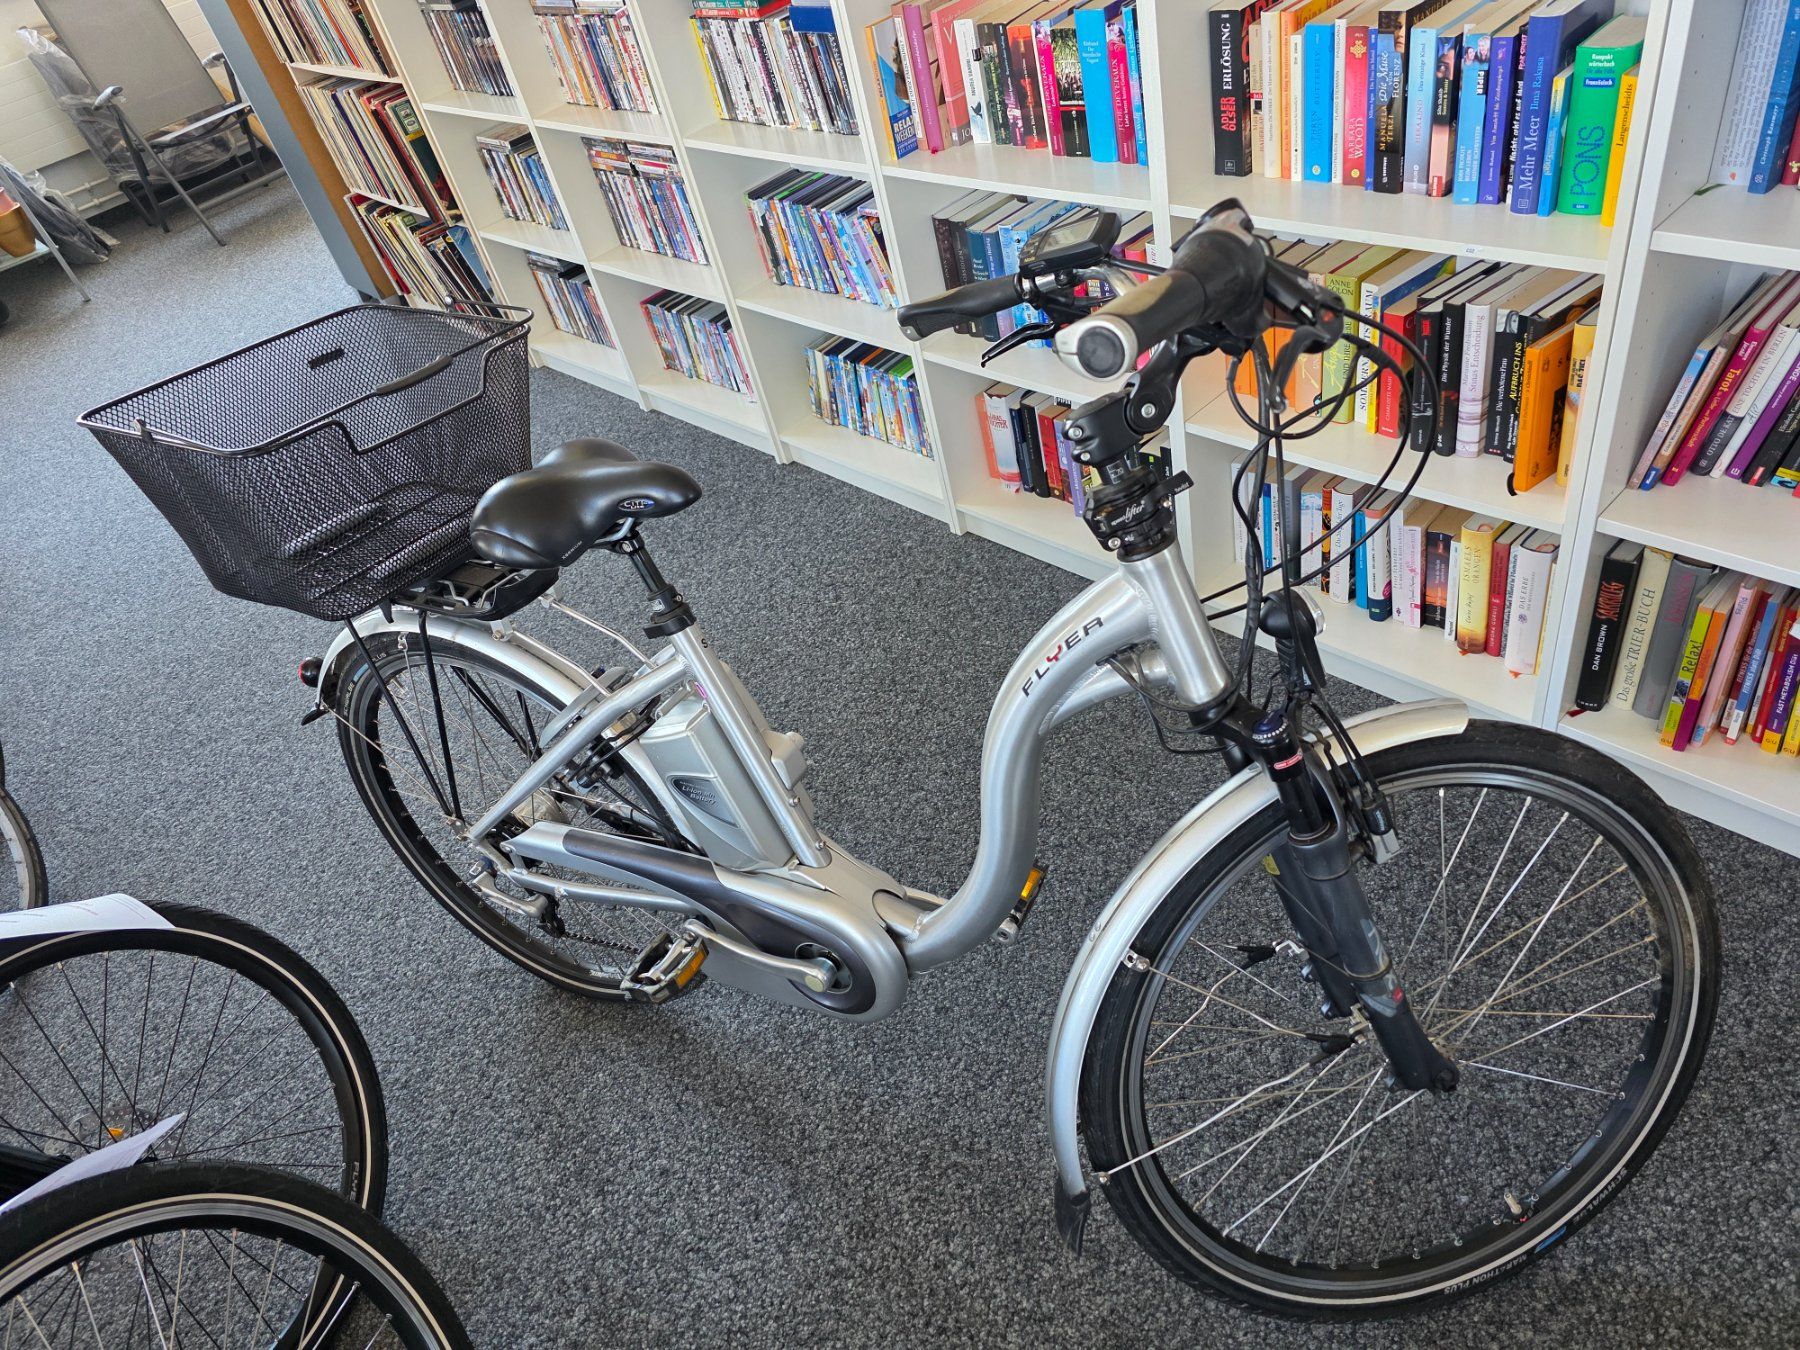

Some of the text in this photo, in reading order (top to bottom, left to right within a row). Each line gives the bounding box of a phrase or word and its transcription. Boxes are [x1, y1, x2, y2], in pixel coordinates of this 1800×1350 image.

[1221, 23, 1232, 90] ERLÖSUNG
[1111, 59, 1121, 106] DEVERAUX
[1377, 51, 1389, 102] Die Muse
[1392, 58, 1400, 98] FLORENZ
[1477, 70, 1485, 94] PIPER
[1221, 96, 1229, 131] ADLER
[1228, 96, 1236, 131] OLSEN
[1379, 105, 1387, 151] MANUELA
[1518, 56, 1544, 190] Mehr Meer Ilma Rakusa
[1616, 83, 1634, 147] Langenscheidts
[895, 127, 915, 143] WEEKEN
[1354, 118, 1364, 158] WOOD
[1509, 137, 1518, 161] Nachts
[1760, 136, 1772, 165] Christoph
[1569, 126, 1606, 196] PONS
[1329, 278, 1351, 289] ANNE
[1442, 352, 1450, 372] Physik
[1469, 315, 1485, 391] Stinas Entscheidung
[1514, 342, 1522, 356] INS
[1742, 365, 1766, 396] TOCHTER
[1766, 329, 1790, 356] BERLIN
[1495, 400, 1503, 411] Die
[1500, 358, 1508, 371] Frau
[1509, 357, 1520, 400] AUFBRUCH
[1718, 368, 1741, 392] Tarot
[1706, 438, 1721, 456] OTTO
[1463, 545, 1472, 582] ISMAELS
[1473, 547, 1481, 584] ORANGEN
[1520, 577, 1528, 594] ERBE
[1596, 581, 1625, 621] SAKRILEG
[1021, 617, 1103, 698] FLYER
[1592, 624, 1608, 670] DAN BROWN
[1616, 587, 1656, 701] Das große TRIER-BUCH
[1681, 639, 1703, 673] Relax!
[1742, 673, 1755, 694] FITNESS
[1780, 665, 1795, 700] METABOLISM
[1775, 700, 1786, 714] FAST
[1443, 1279, 1471, 1295] PLUS
